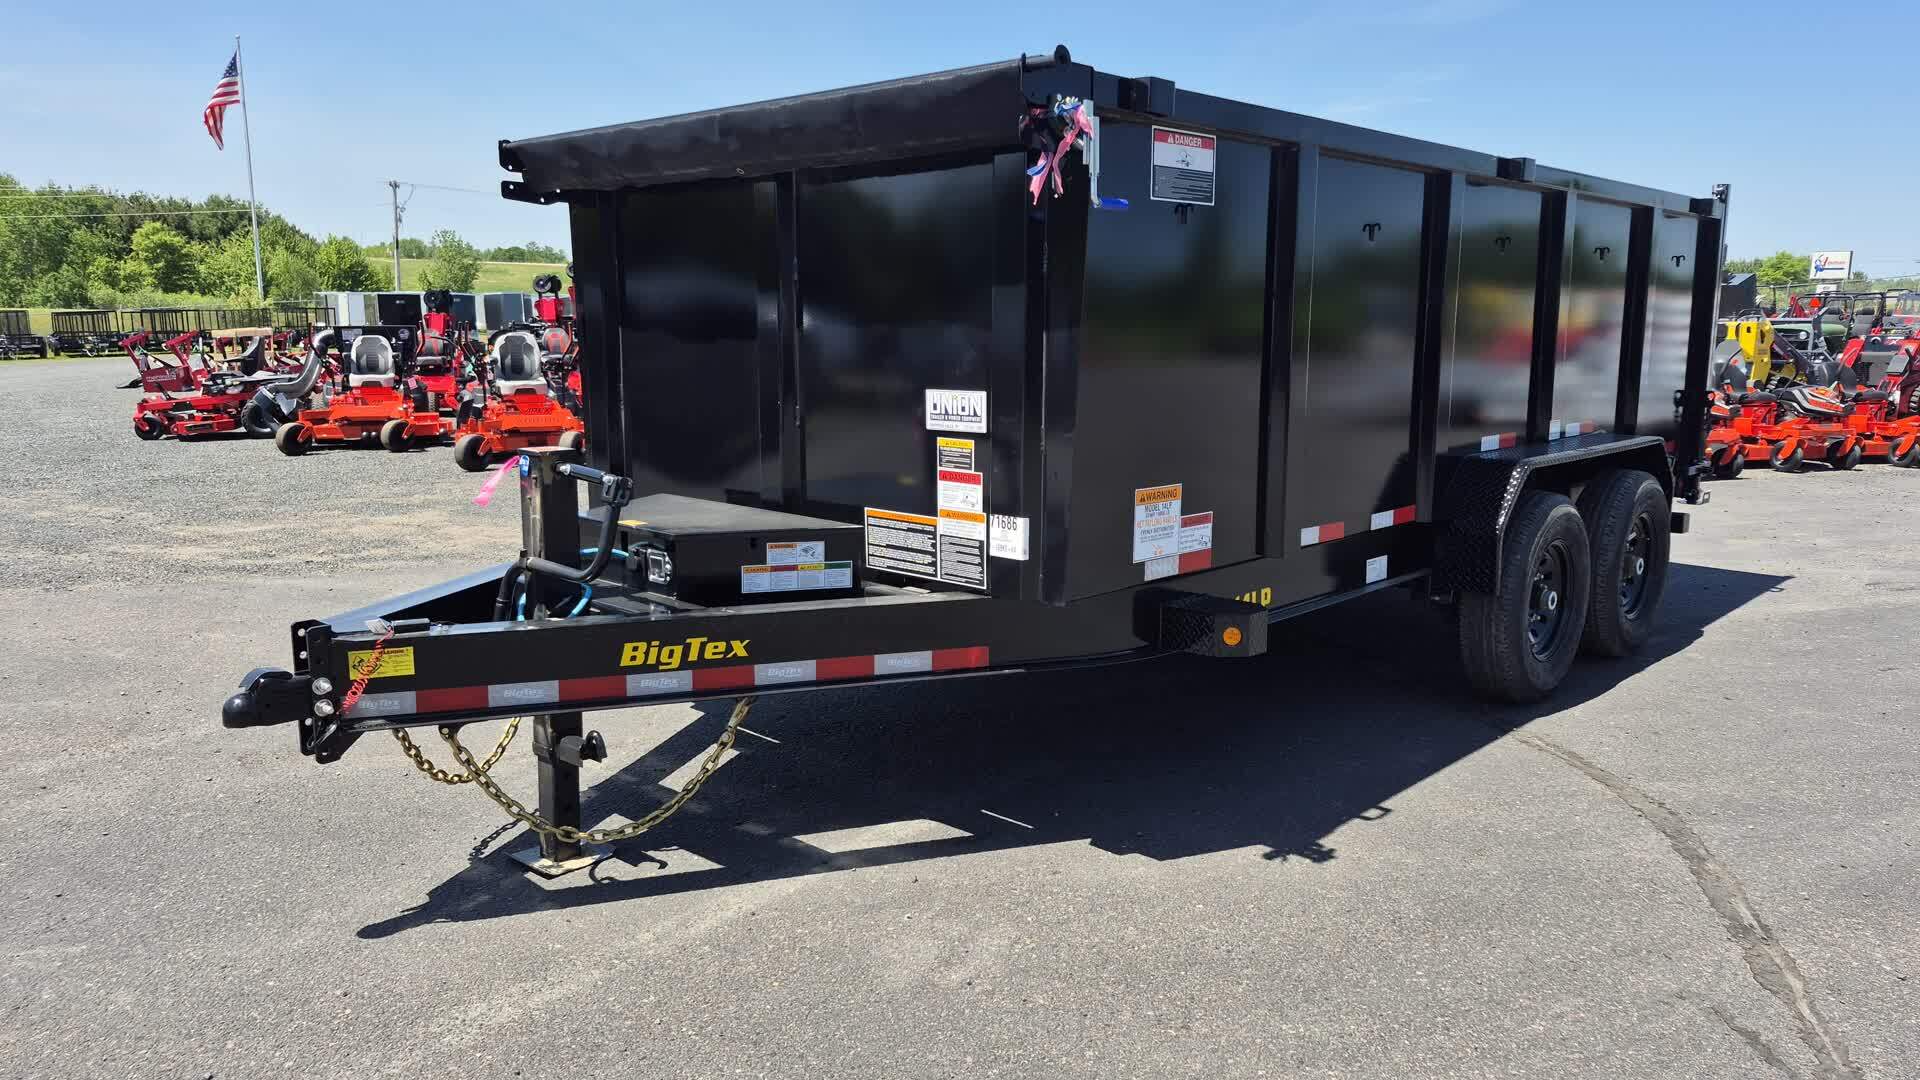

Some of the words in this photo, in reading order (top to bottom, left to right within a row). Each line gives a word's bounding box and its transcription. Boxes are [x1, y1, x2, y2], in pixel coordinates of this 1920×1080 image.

[1174, 134, 1202, 148] DANGER
[930, 391, 983, 417] UNION
[1145, 488, 1178, 502] WARNING
[1144, 503, 1160, 512] MODEL
[991, 515, 1018, 531] 71686
[619, 636, 752, 670] BigTex
[768, 668, 801, 677] BigTex
[640, 678, 680, 689] BigTex
[503, 688, 545, 699] BigTex
